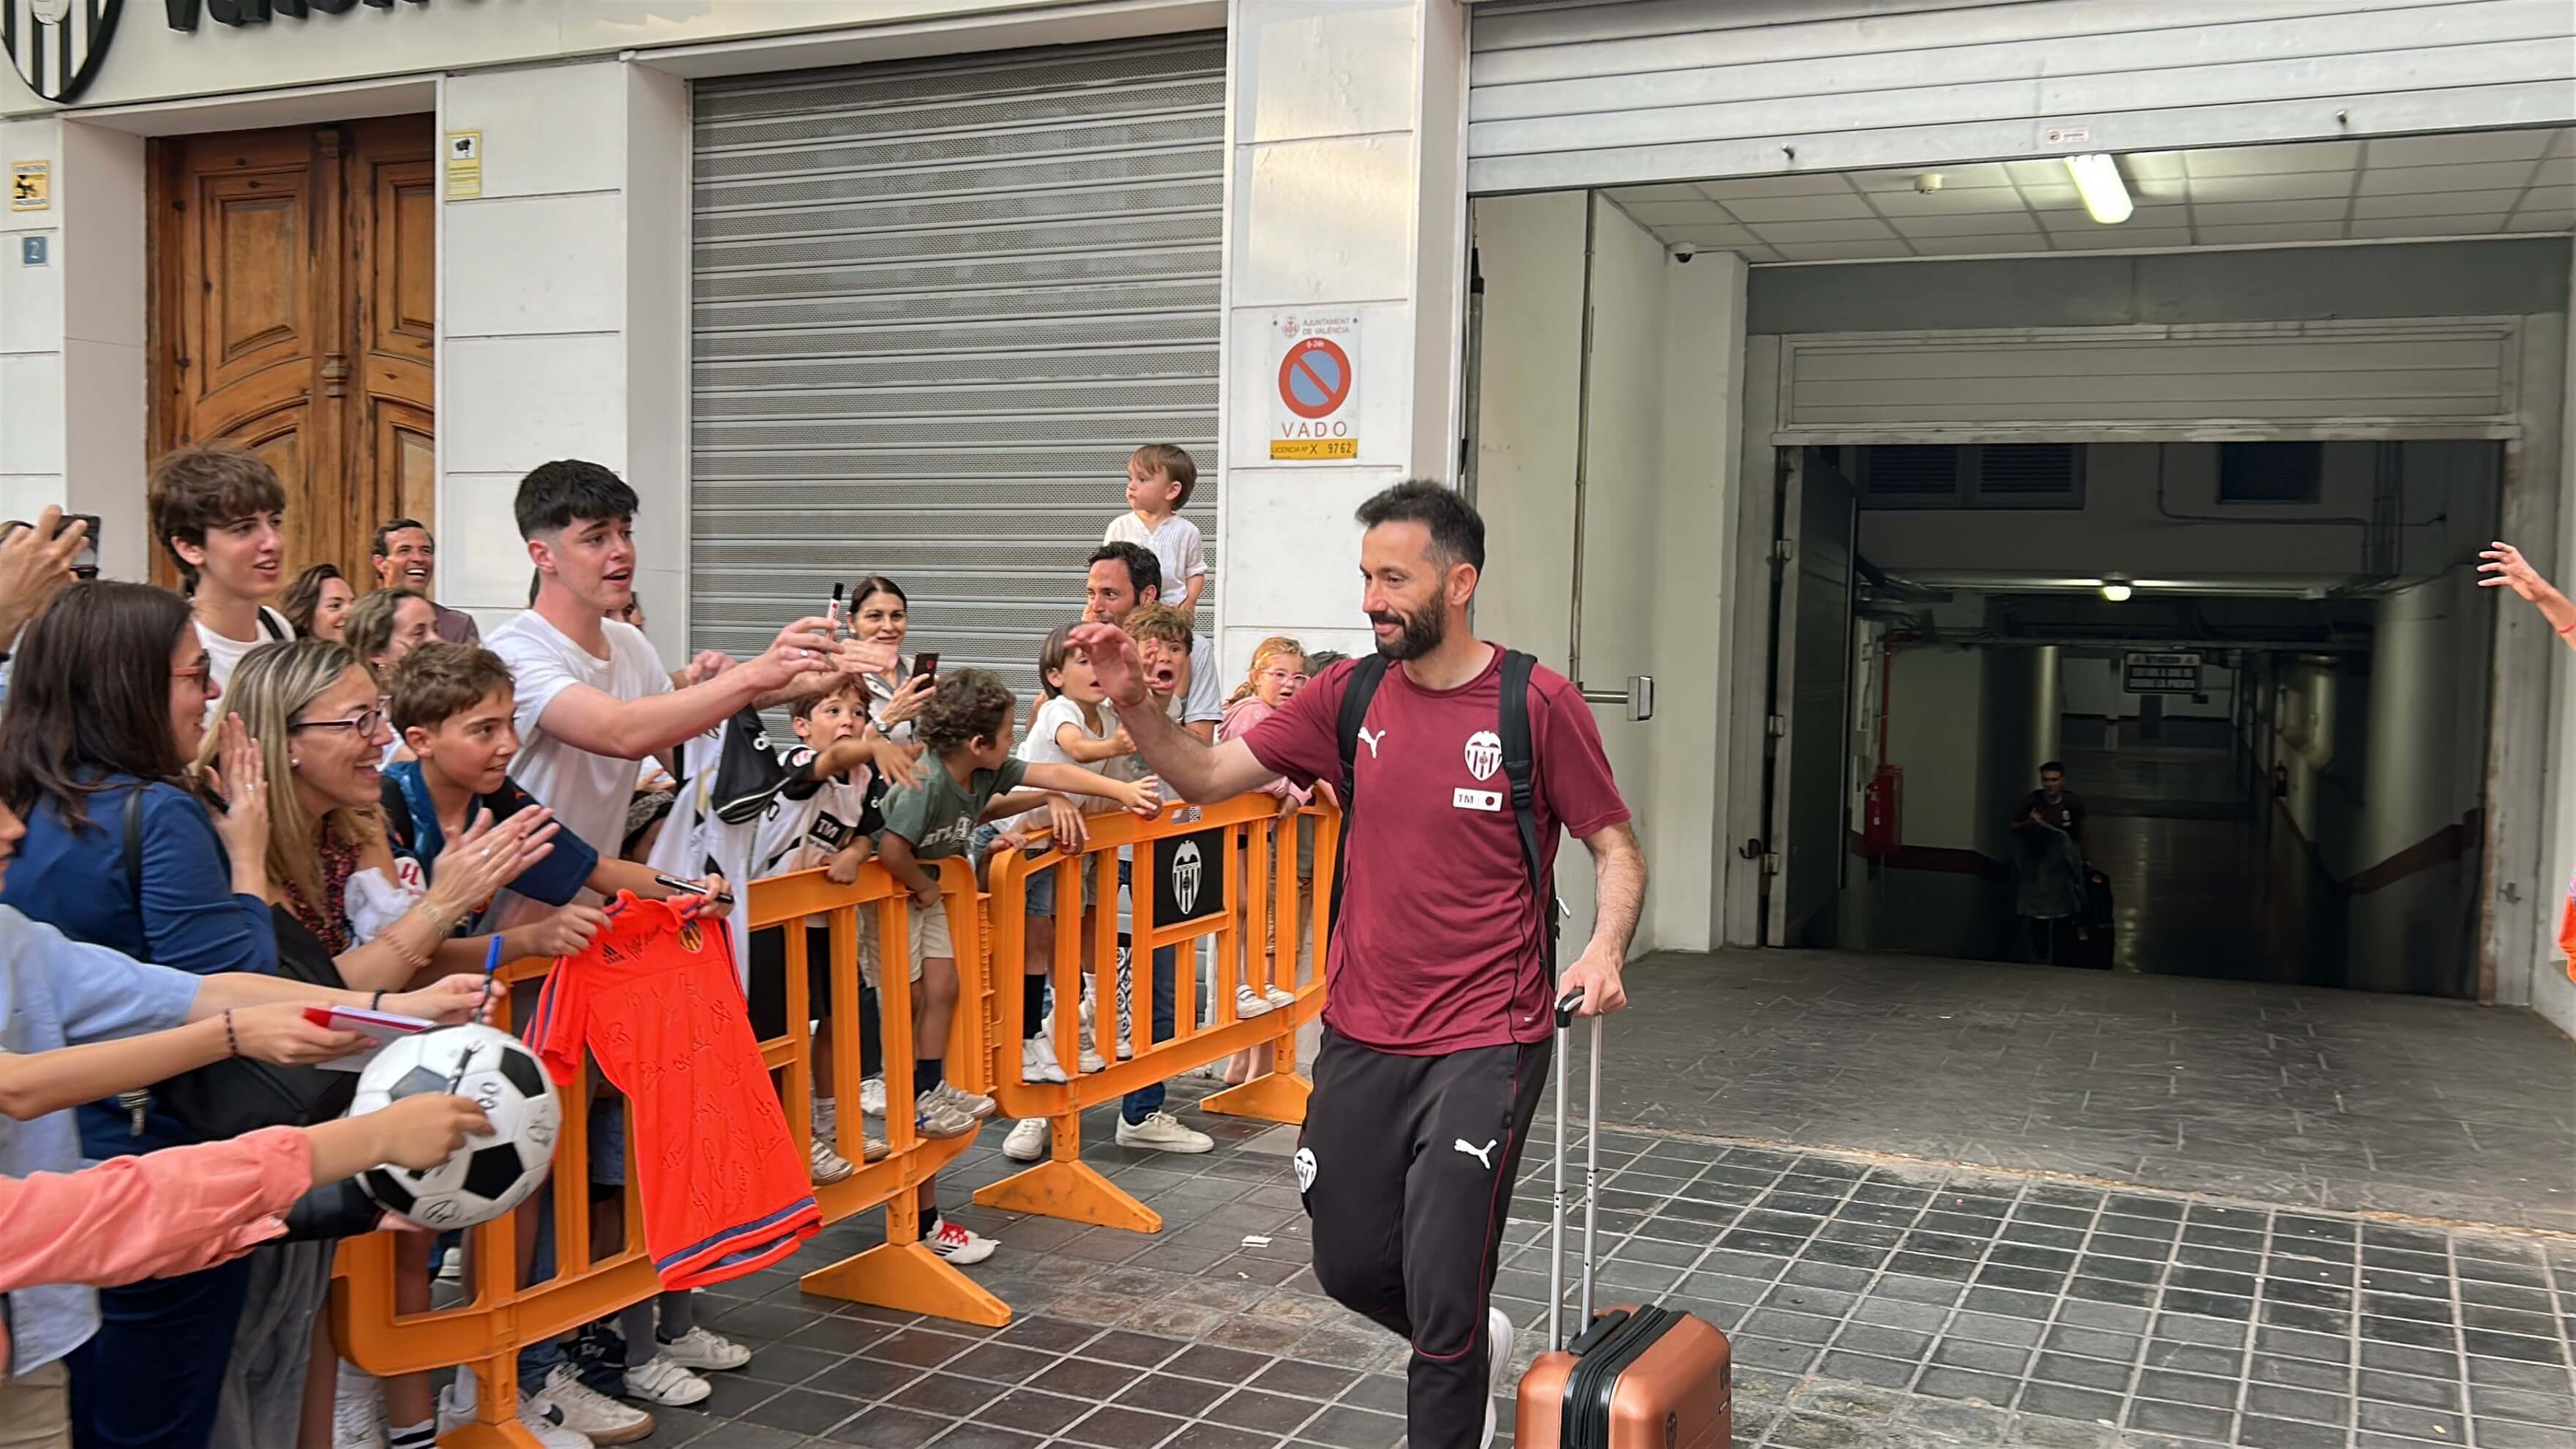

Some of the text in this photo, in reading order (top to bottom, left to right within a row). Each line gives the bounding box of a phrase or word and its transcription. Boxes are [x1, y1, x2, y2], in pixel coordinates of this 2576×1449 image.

[29, 241, 40, 259] 2
[1303, 318, 1349, 326] AJUNTAMENT
[1282, 422, 1347, 438] VADO
[1309, 444, 1318, 454] X
[1328, 443, 1352, 454] 9762
[1459, 794, 1473, 804] TM
